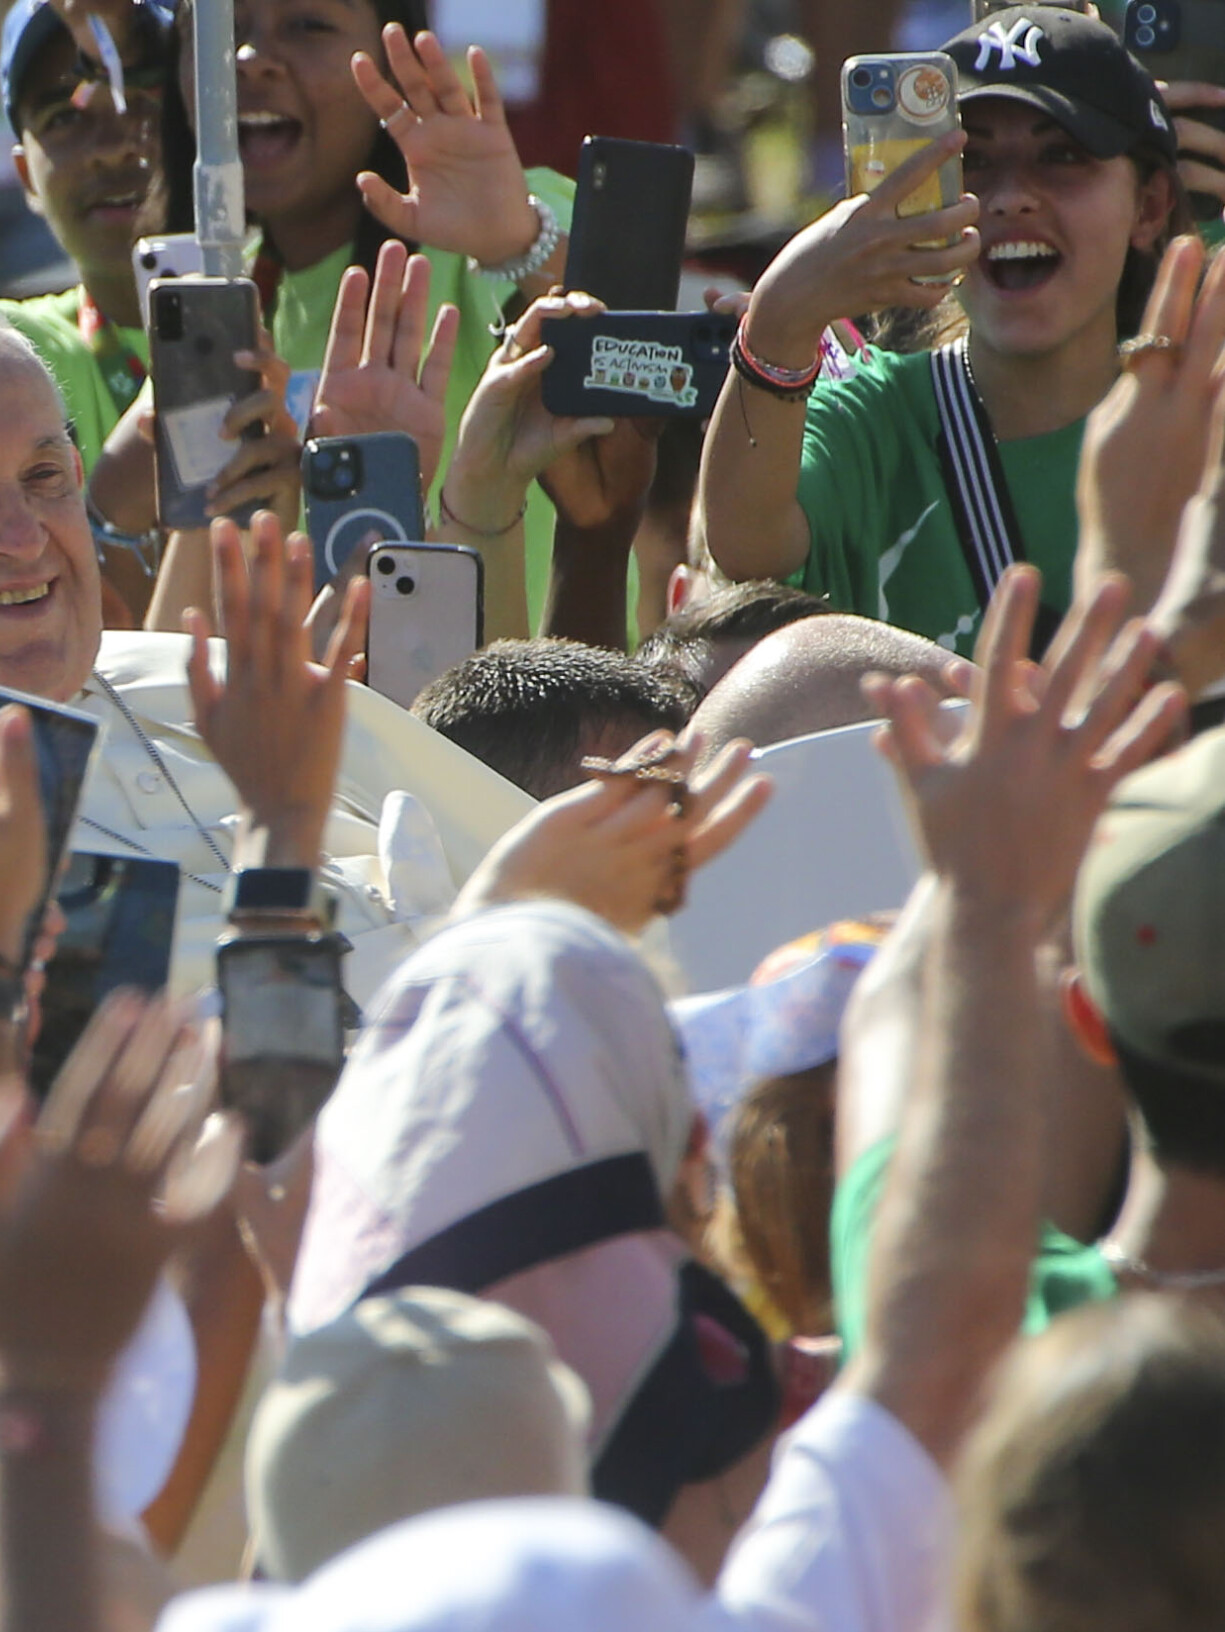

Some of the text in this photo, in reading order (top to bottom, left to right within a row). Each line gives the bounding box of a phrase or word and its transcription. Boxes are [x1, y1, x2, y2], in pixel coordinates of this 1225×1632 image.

[974, 16, 1044, 71] NY
[595, 340, 679, 361] EDUCATION
[609, 358, 668, 374] ACTIVISM
